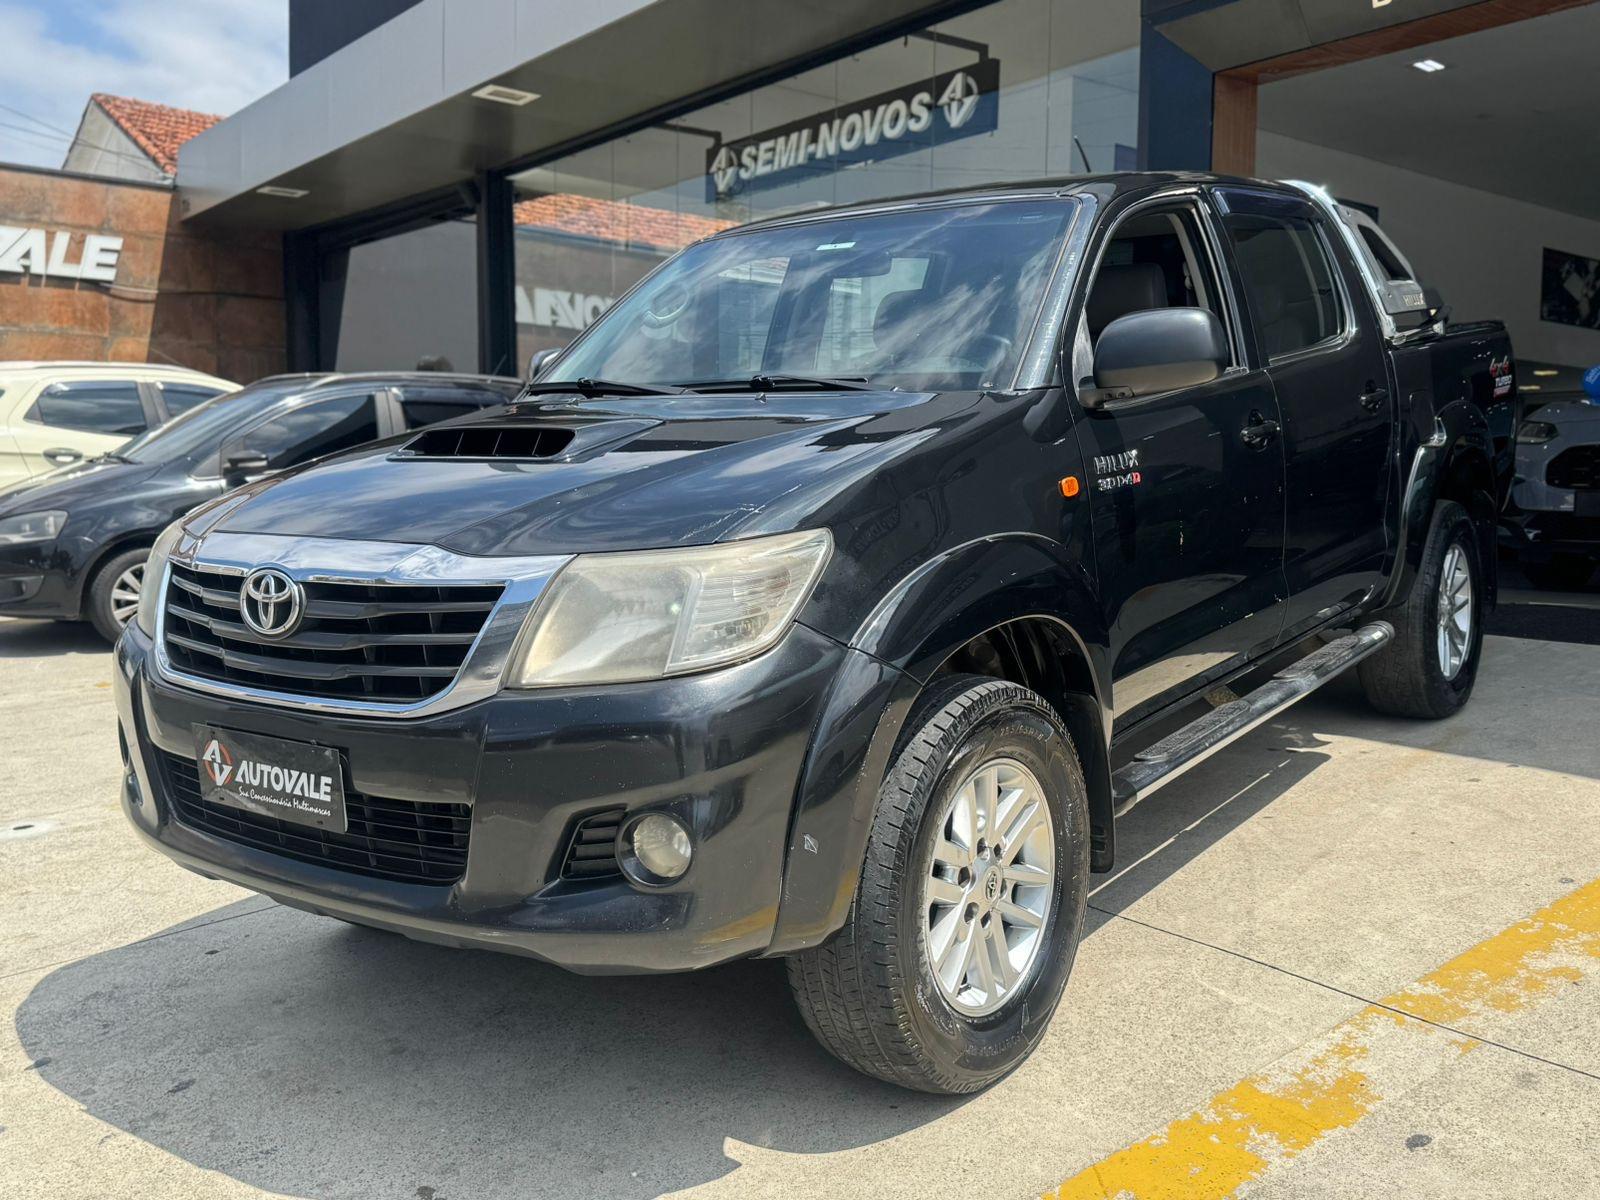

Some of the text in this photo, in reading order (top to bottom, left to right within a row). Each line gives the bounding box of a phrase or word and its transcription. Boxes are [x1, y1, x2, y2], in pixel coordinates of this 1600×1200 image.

[738, 92, 932, 180] SEMI-NOVOS
[1094, 449, 1139, 474] HILUX
[234, 760, 333, 803] AUTOVALE
[238, 786, 250, 797] Sua
[293, 797, 331, 817] Multimarcas
